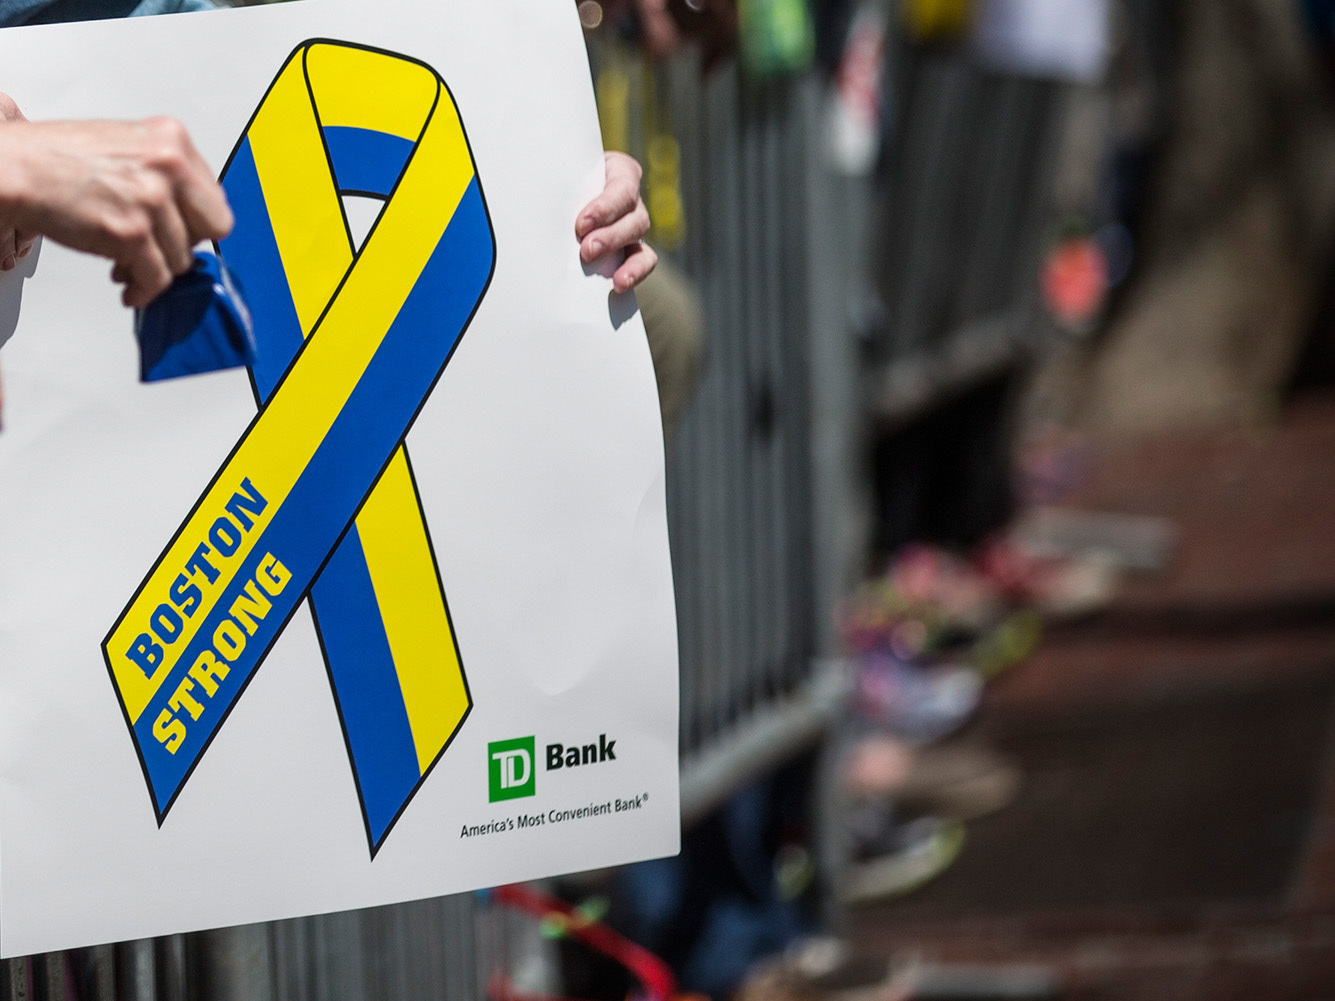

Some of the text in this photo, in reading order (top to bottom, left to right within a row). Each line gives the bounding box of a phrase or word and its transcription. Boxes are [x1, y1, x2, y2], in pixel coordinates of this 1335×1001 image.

[125, 476, 268, 680] BOSTON
[152, 551, 292, 755] STRONG
[460, 817, 514, 839] America's
[517, 812, 545, 829] Most
[548, 801, 611, 823] Convenient
[492, 733, 617, 789] TD Bank
